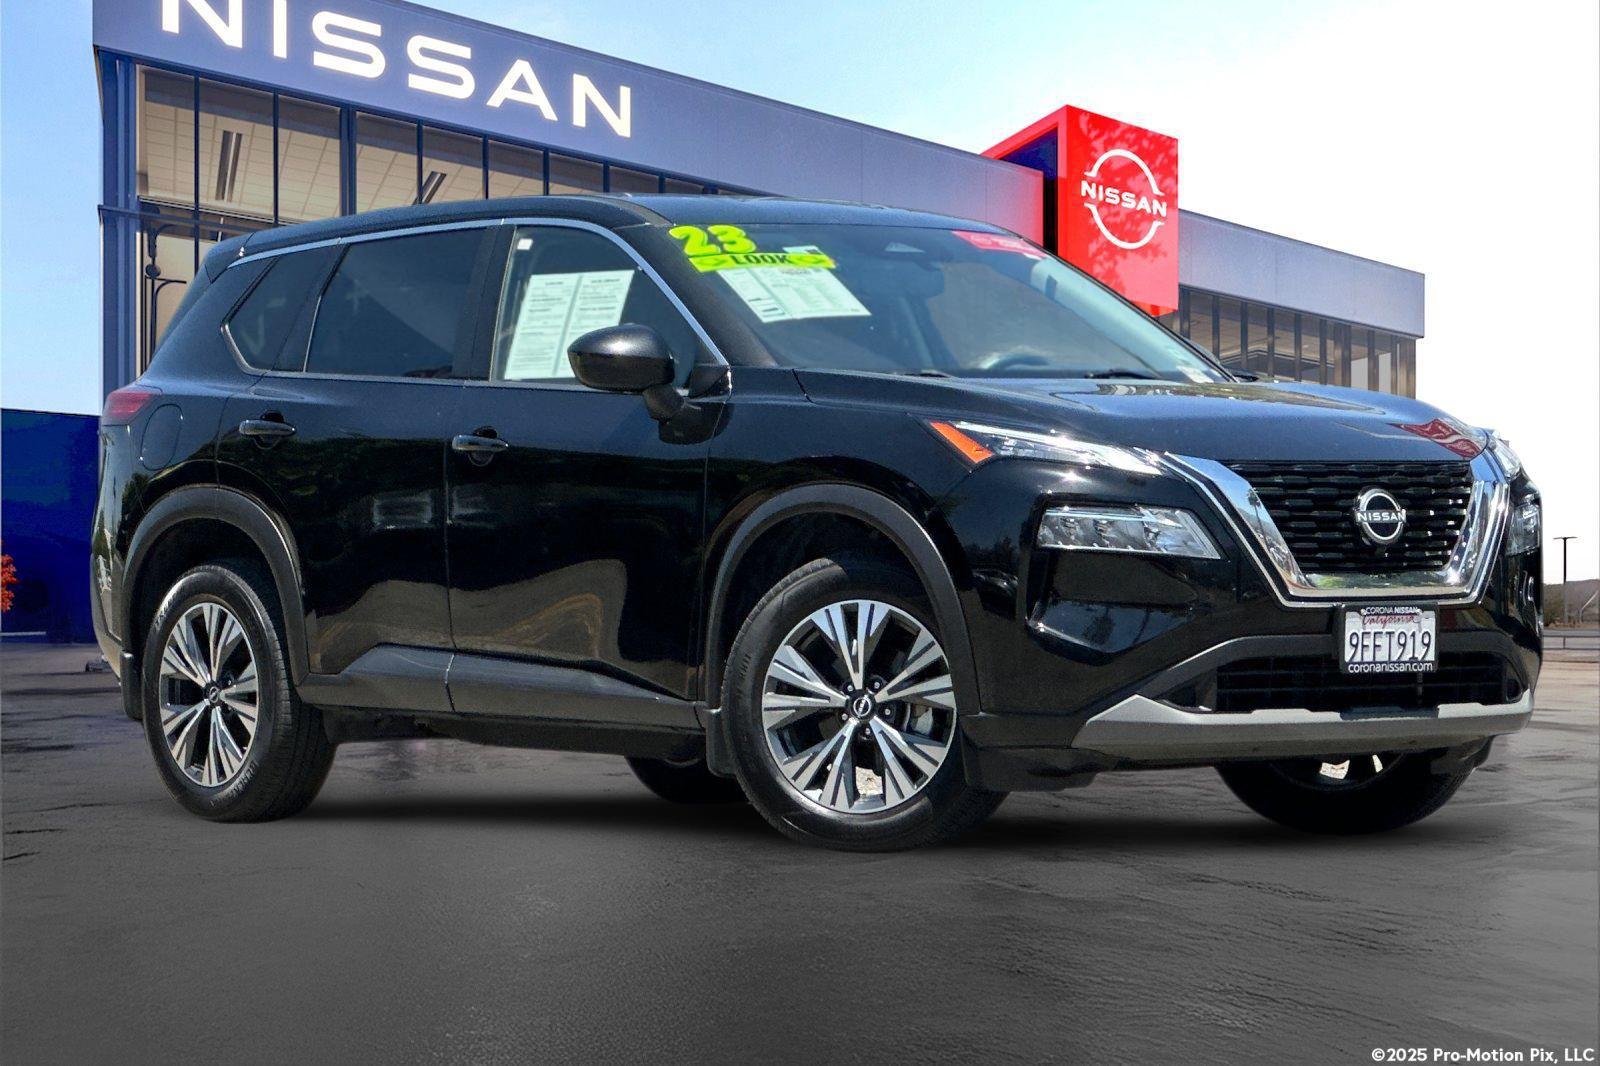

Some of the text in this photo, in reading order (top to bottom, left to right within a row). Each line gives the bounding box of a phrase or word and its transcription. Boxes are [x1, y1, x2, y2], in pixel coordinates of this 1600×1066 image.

[161, 0, 632, 138] NISSAN
[1080, 179, 1168, 217] NISSAN
[668, 225, 757, 255] 23
[729, 253, 793, 265] LOOK
[1357, 510, 1407, 522] NISSAN
[1394, 606, 1419, 614] NISSAN
[1362, 614, 1416, 628] California
[1349, 630, 1432, 662] 9FFT919
[1348, 662, 1433, 673] coronanissan.com
